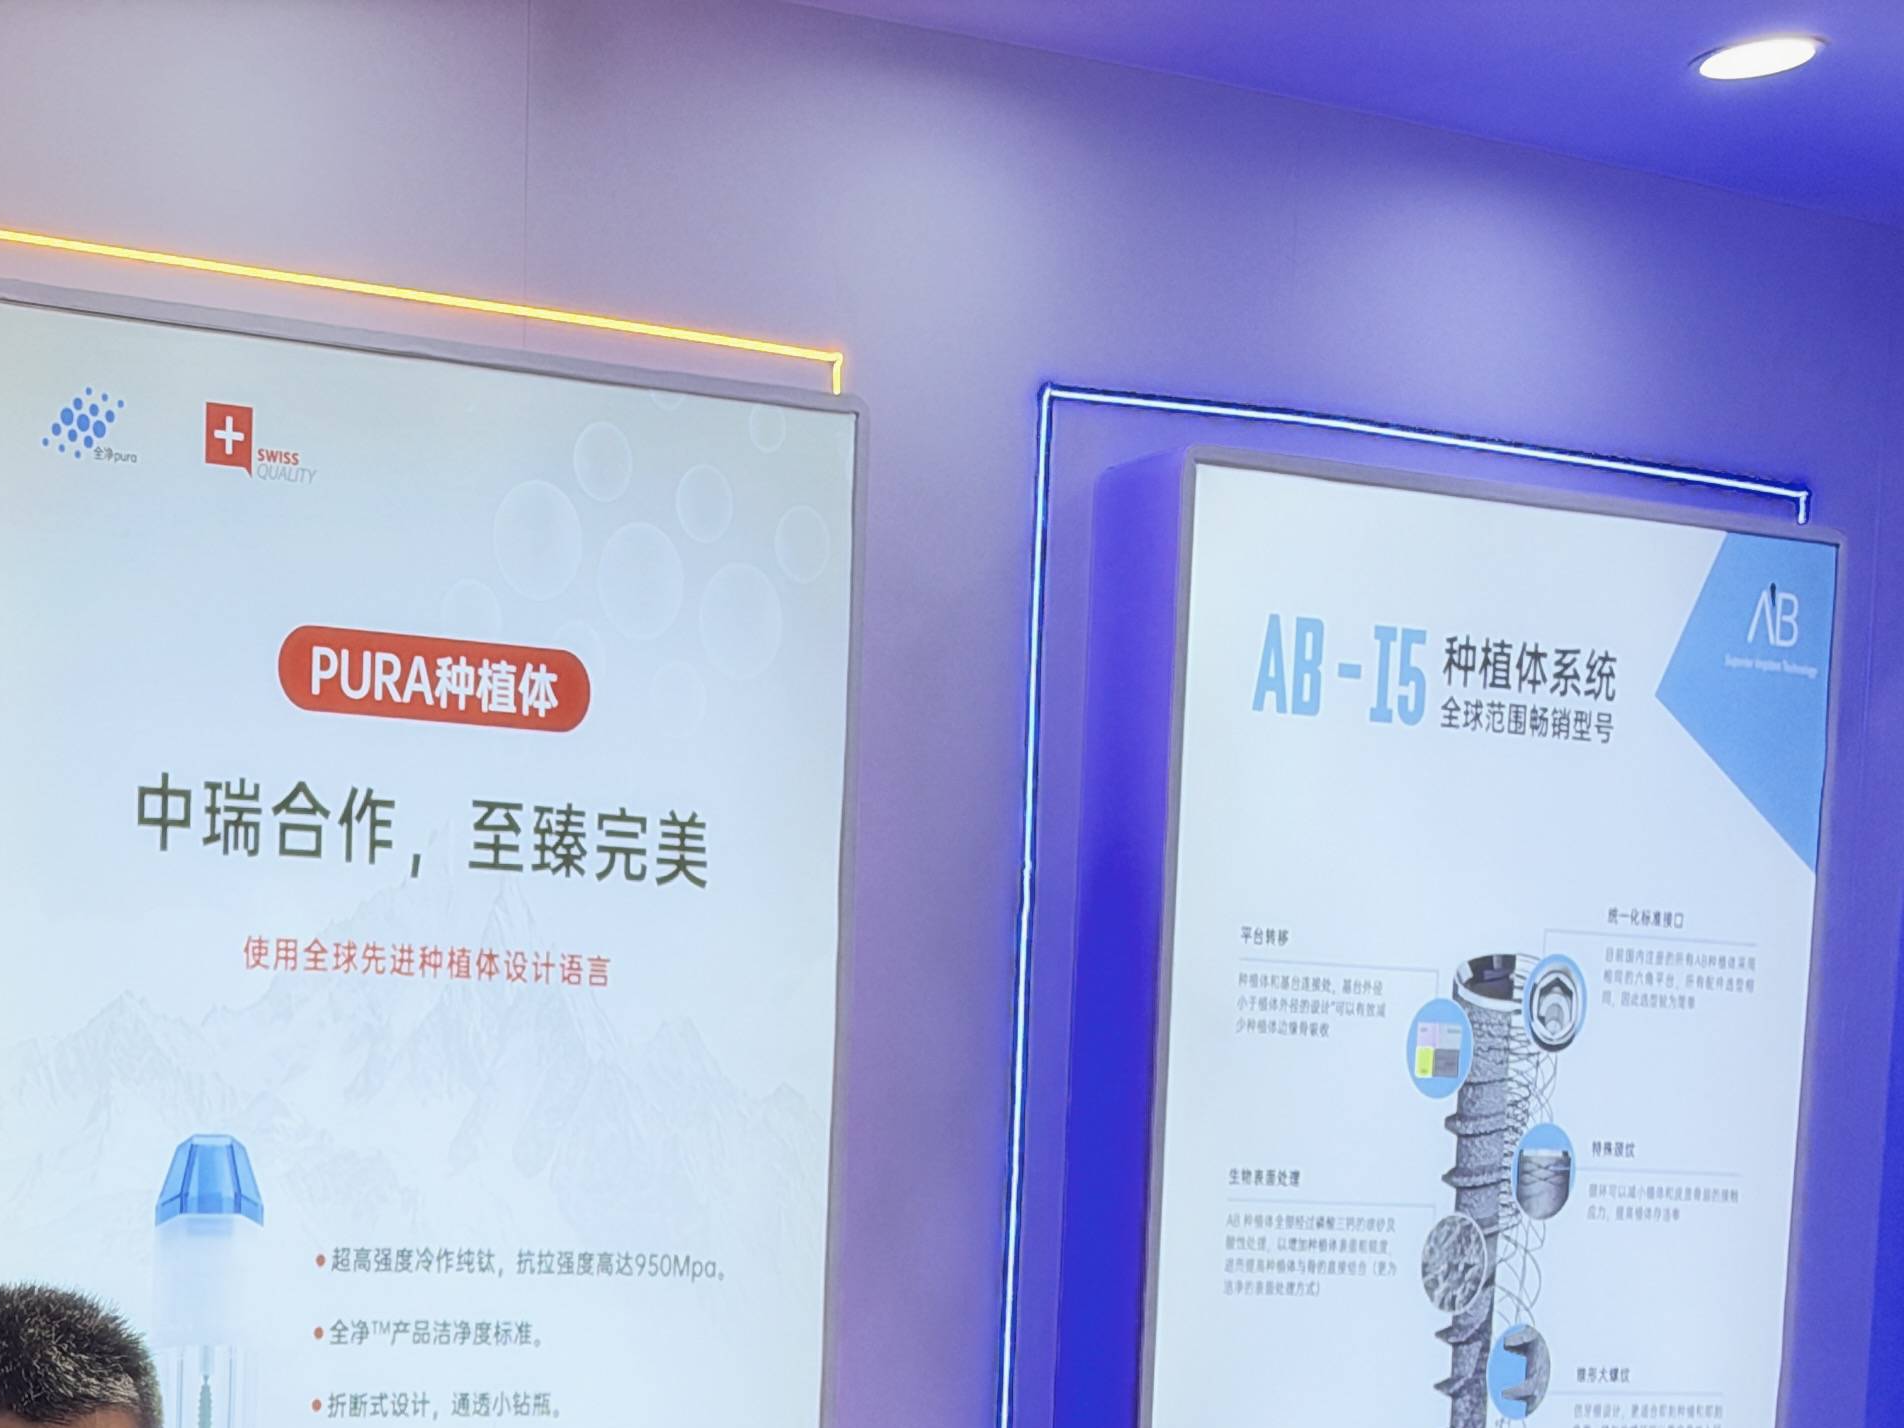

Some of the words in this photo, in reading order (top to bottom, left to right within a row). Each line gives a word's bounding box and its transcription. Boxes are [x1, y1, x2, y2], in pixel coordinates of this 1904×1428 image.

[256, 463, 318, 486] QUALITY
[257, 448, 300, 466] SWISS
[310, 644, 559, 719] PURA种植体
[1443, 634, 1618, 702] 种植体系统
[1440, 696, 1614, 744] 全球范围畅销型号
[136, 771, 710, 890] 中瑞合作，至臻完美
[1240, 926, 1289, 946] 平台转移
[243, 935, 612, 989] 使用全球先进种植体设计语言
[1228, 1168, 1300, 1187] 生物表面处理
